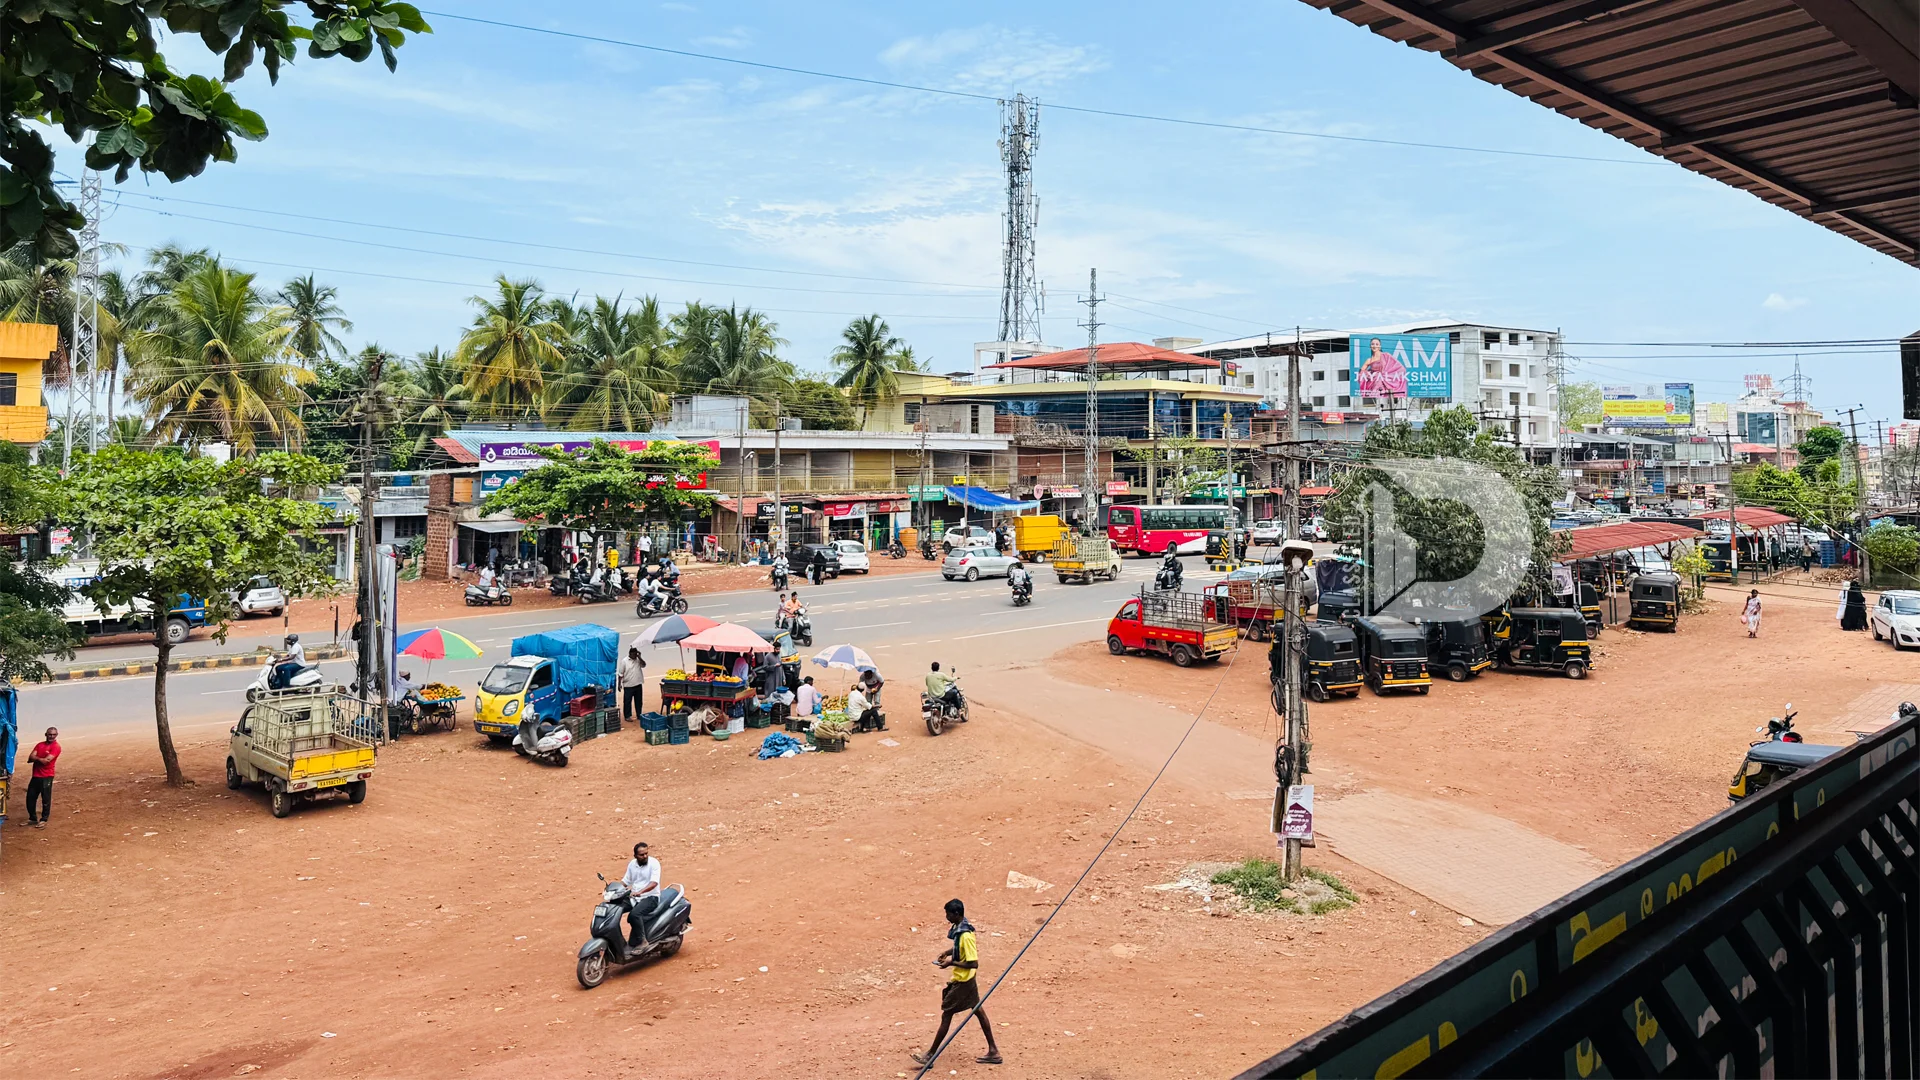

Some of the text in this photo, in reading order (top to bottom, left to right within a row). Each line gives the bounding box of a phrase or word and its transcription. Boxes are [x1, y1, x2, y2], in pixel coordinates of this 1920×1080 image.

[1392, 337, 1446, 368] AM
[1353, 371, 1446, 382] JAYALAKSHMI
[335, 509, 360, 519] ARE
